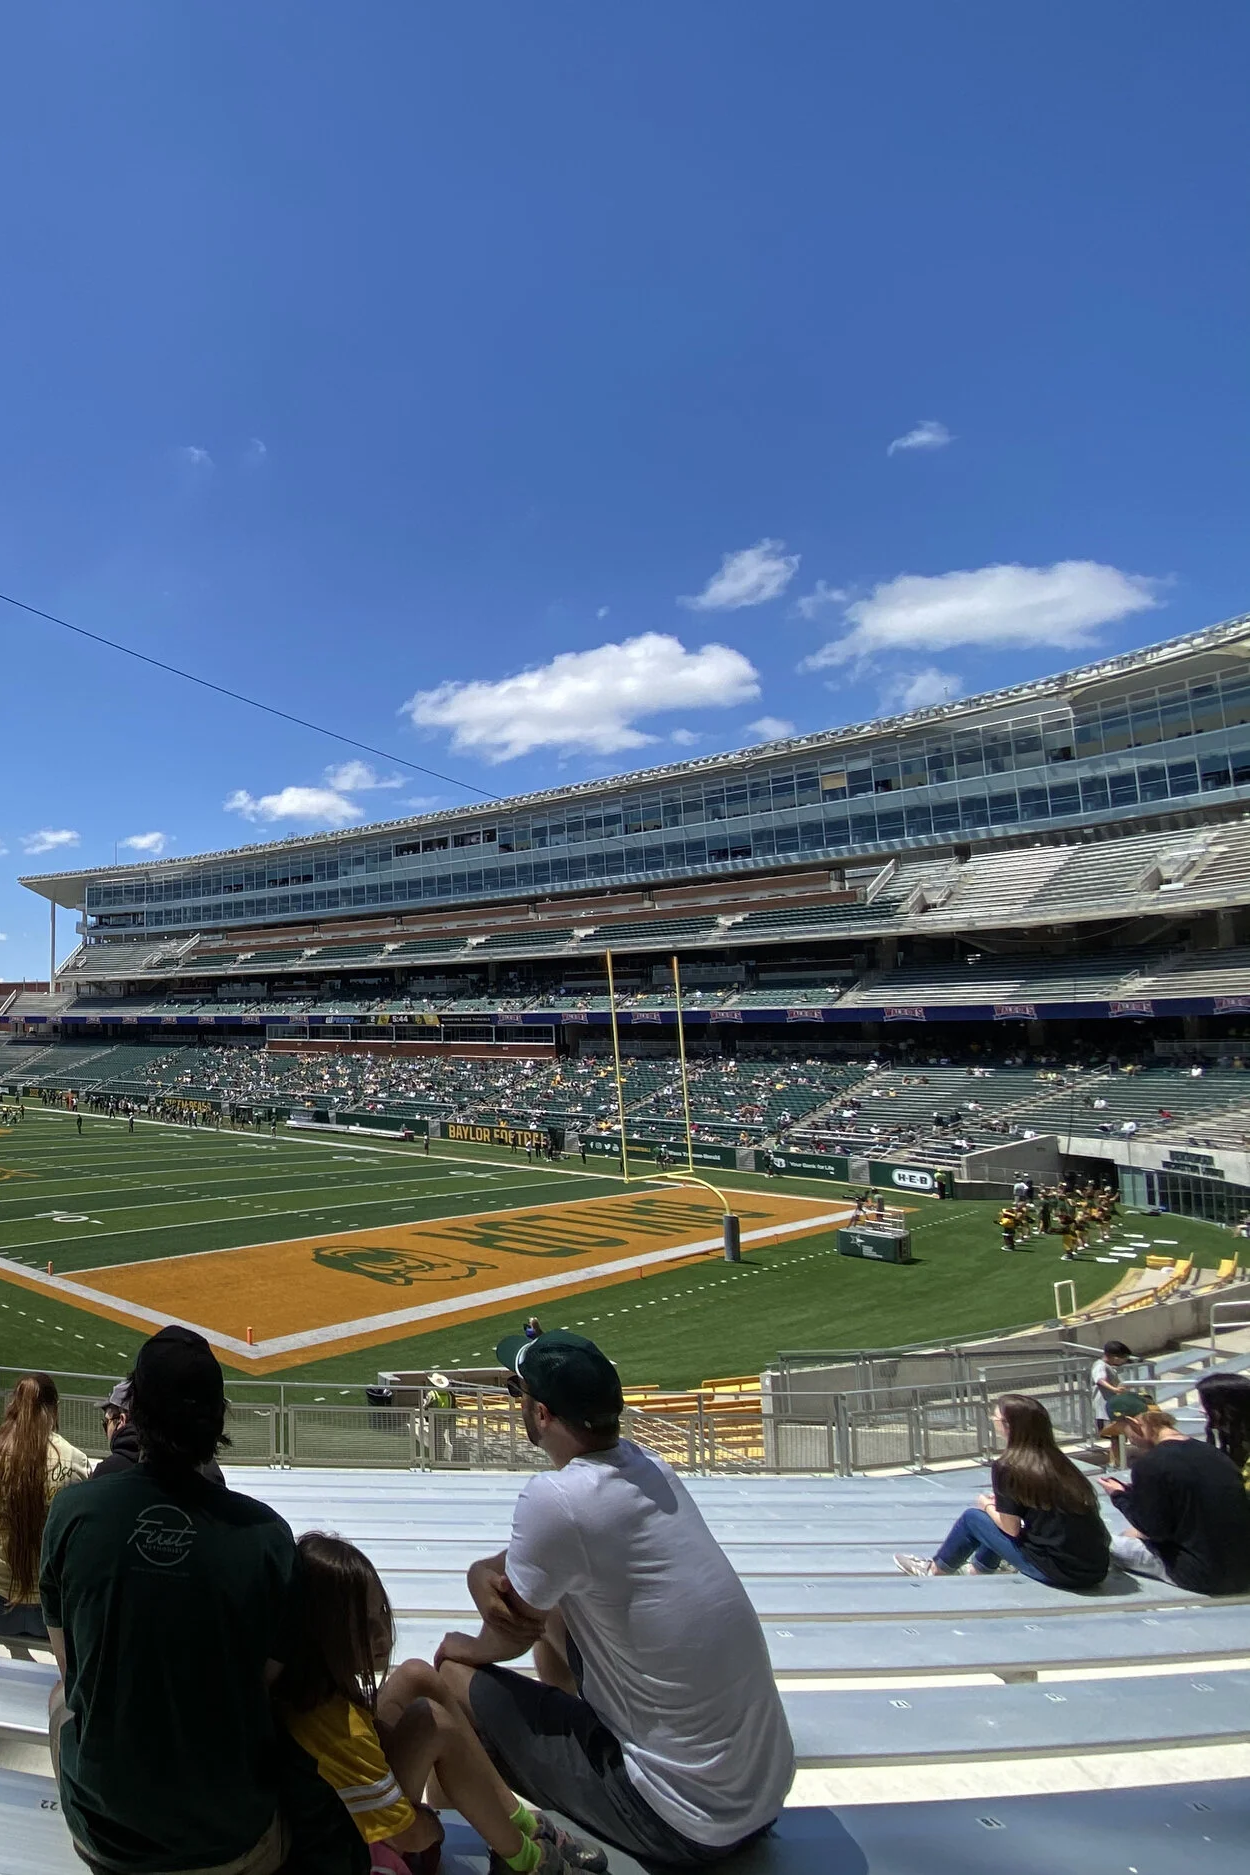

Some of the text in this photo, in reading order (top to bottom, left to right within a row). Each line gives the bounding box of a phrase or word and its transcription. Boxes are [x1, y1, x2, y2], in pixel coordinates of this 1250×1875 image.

[392, 1015, 409, 1023] 5:44
[448, 1125, 491, 1142] BAYLOR
[897, 1173, 928, 1186] H-E-B
[51, 1461, 73, 1482] Oso
[127, 1518, 197, 1547] First
[40, 1799, 59, 1810] 22
